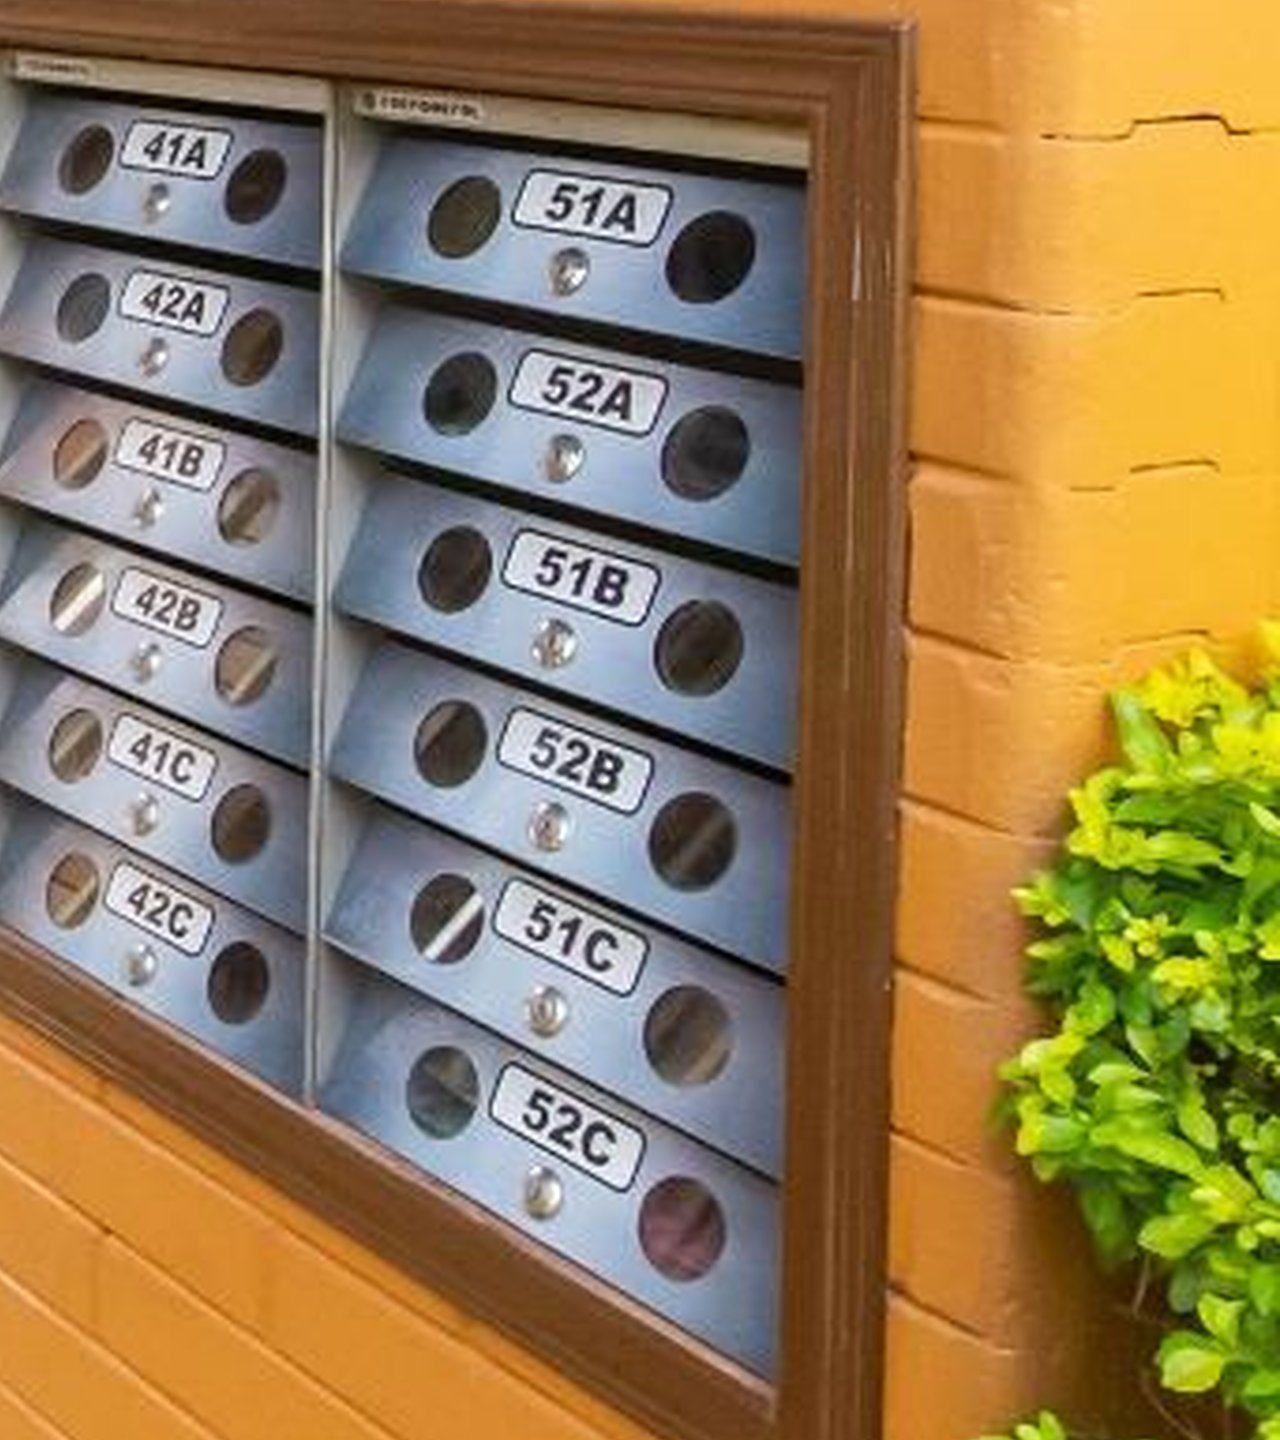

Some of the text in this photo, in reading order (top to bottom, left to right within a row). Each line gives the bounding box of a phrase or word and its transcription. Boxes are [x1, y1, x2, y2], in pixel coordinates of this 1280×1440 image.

[143, 130, 208, 170] 41A
[544, 182, 639, 235] 51A
[141, 282, 207, 325] 42A
[540, 364, 635, 421] 52A
[139, 433, 206, 479] 41B
[535, 546, 631, 610] 51B
[135, 583, 202, 633] 42B
[129, 732, 197, 787] 41C
[528, 725, 626, 796] 52B
[125, 882, 195, 941] 42C
[524, 900, 620, 975] 51C
[520, 1087, 618, 1169] 52C
